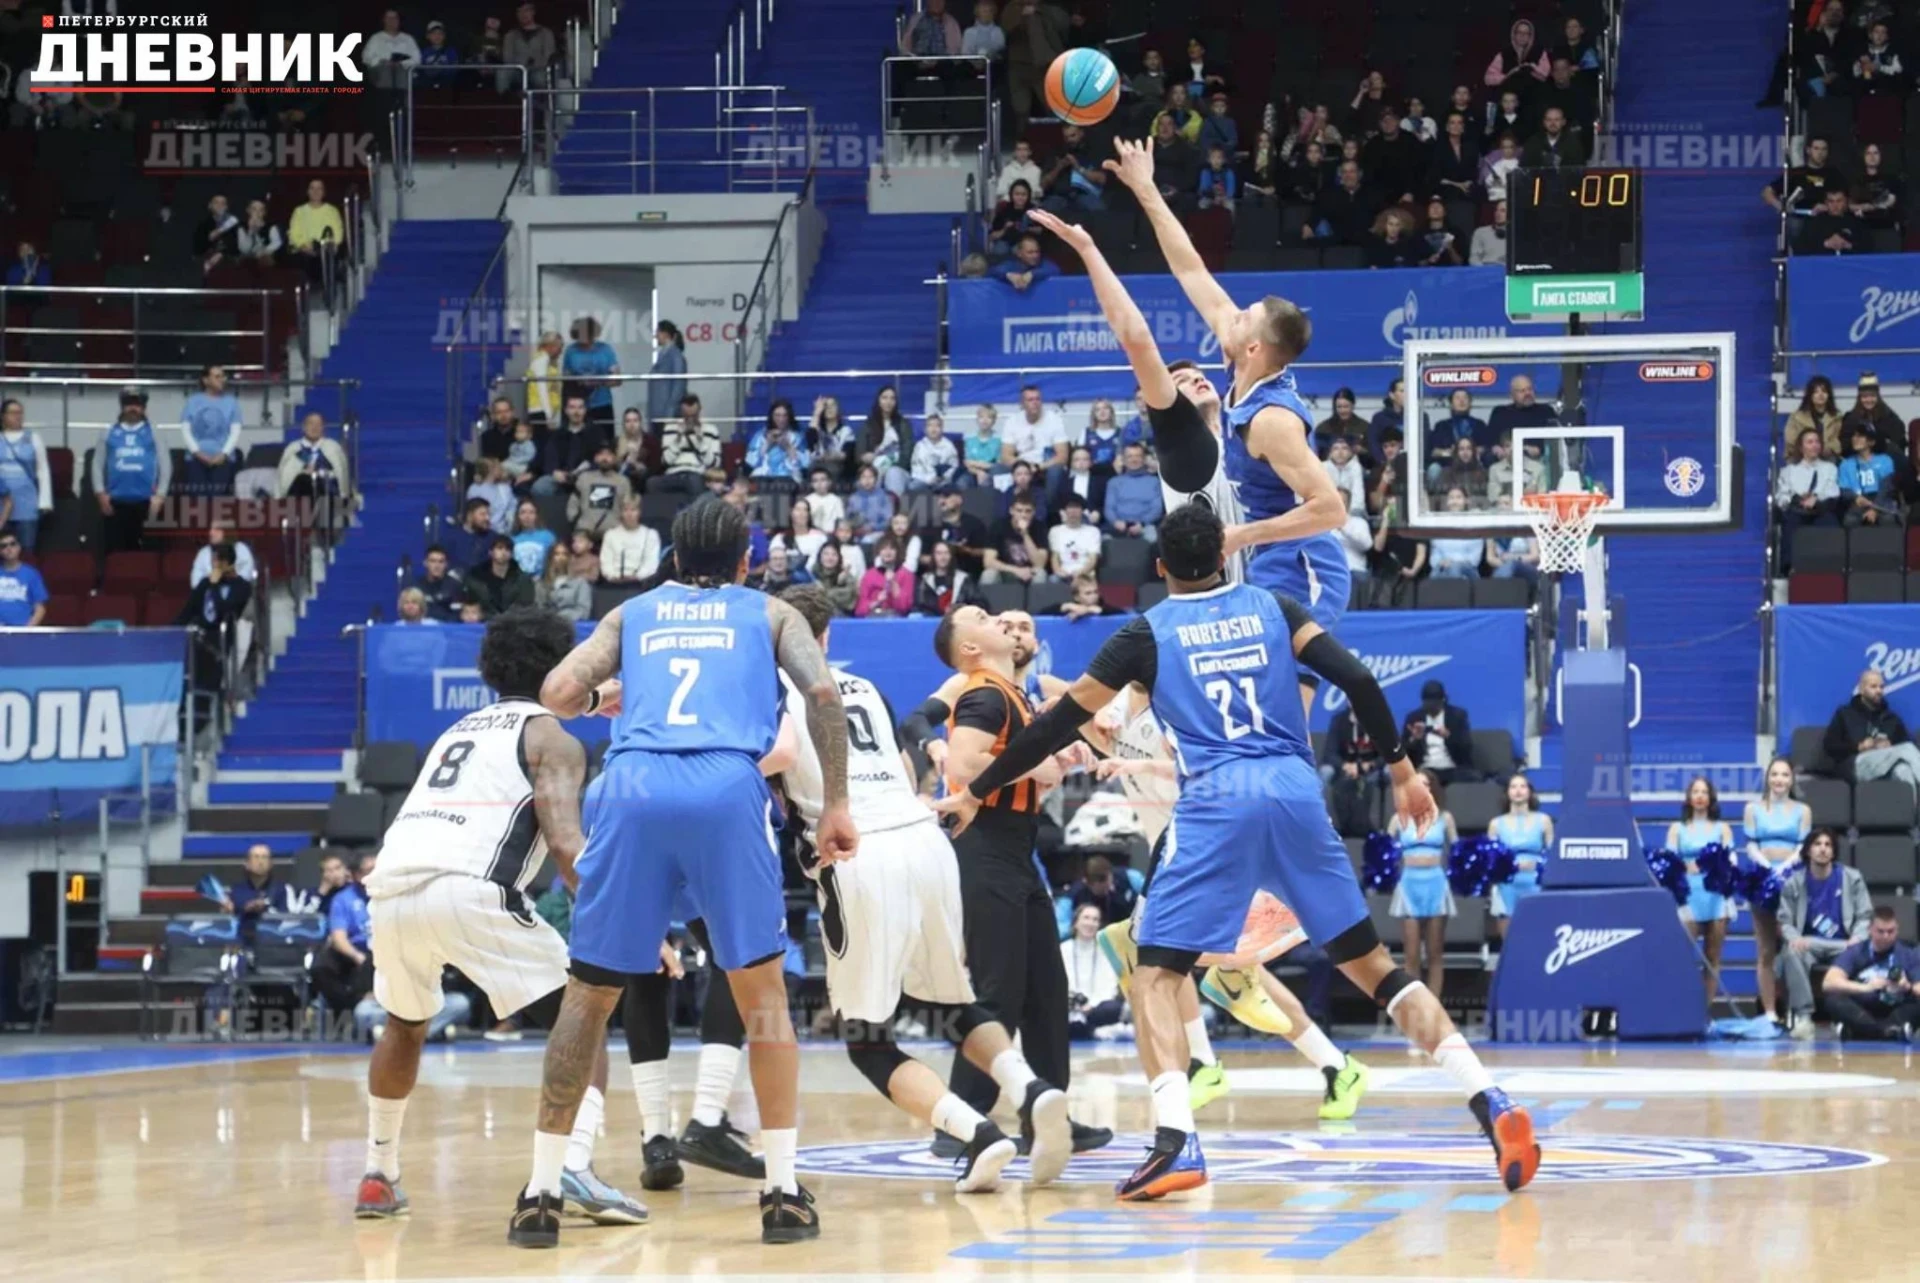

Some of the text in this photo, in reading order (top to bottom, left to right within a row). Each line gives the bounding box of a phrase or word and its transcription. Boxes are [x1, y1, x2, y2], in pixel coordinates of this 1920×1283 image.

[685, 296, 725, 308] Партер
[732, 292, 748, 312] D
[1014, 330, 1120, 354] ЛИГА СТАВОК
[1429, 370, 1481, 383] WINLINE
[1644, 365, 1698, 378] WINLINE
[656, 600, 727, 621] MASON
[1175, 613, 1265, 648] ROBERSON
[446, 685, 491, 710] ЛИГА
[667, 657, 701, 726] 2
[1205, 676, 1267, 742] 21
[0, 688, 127, 761] ОЛА
[428, 740, 476, 789] 8
[1544, 923, 1644, 975] Зенит
